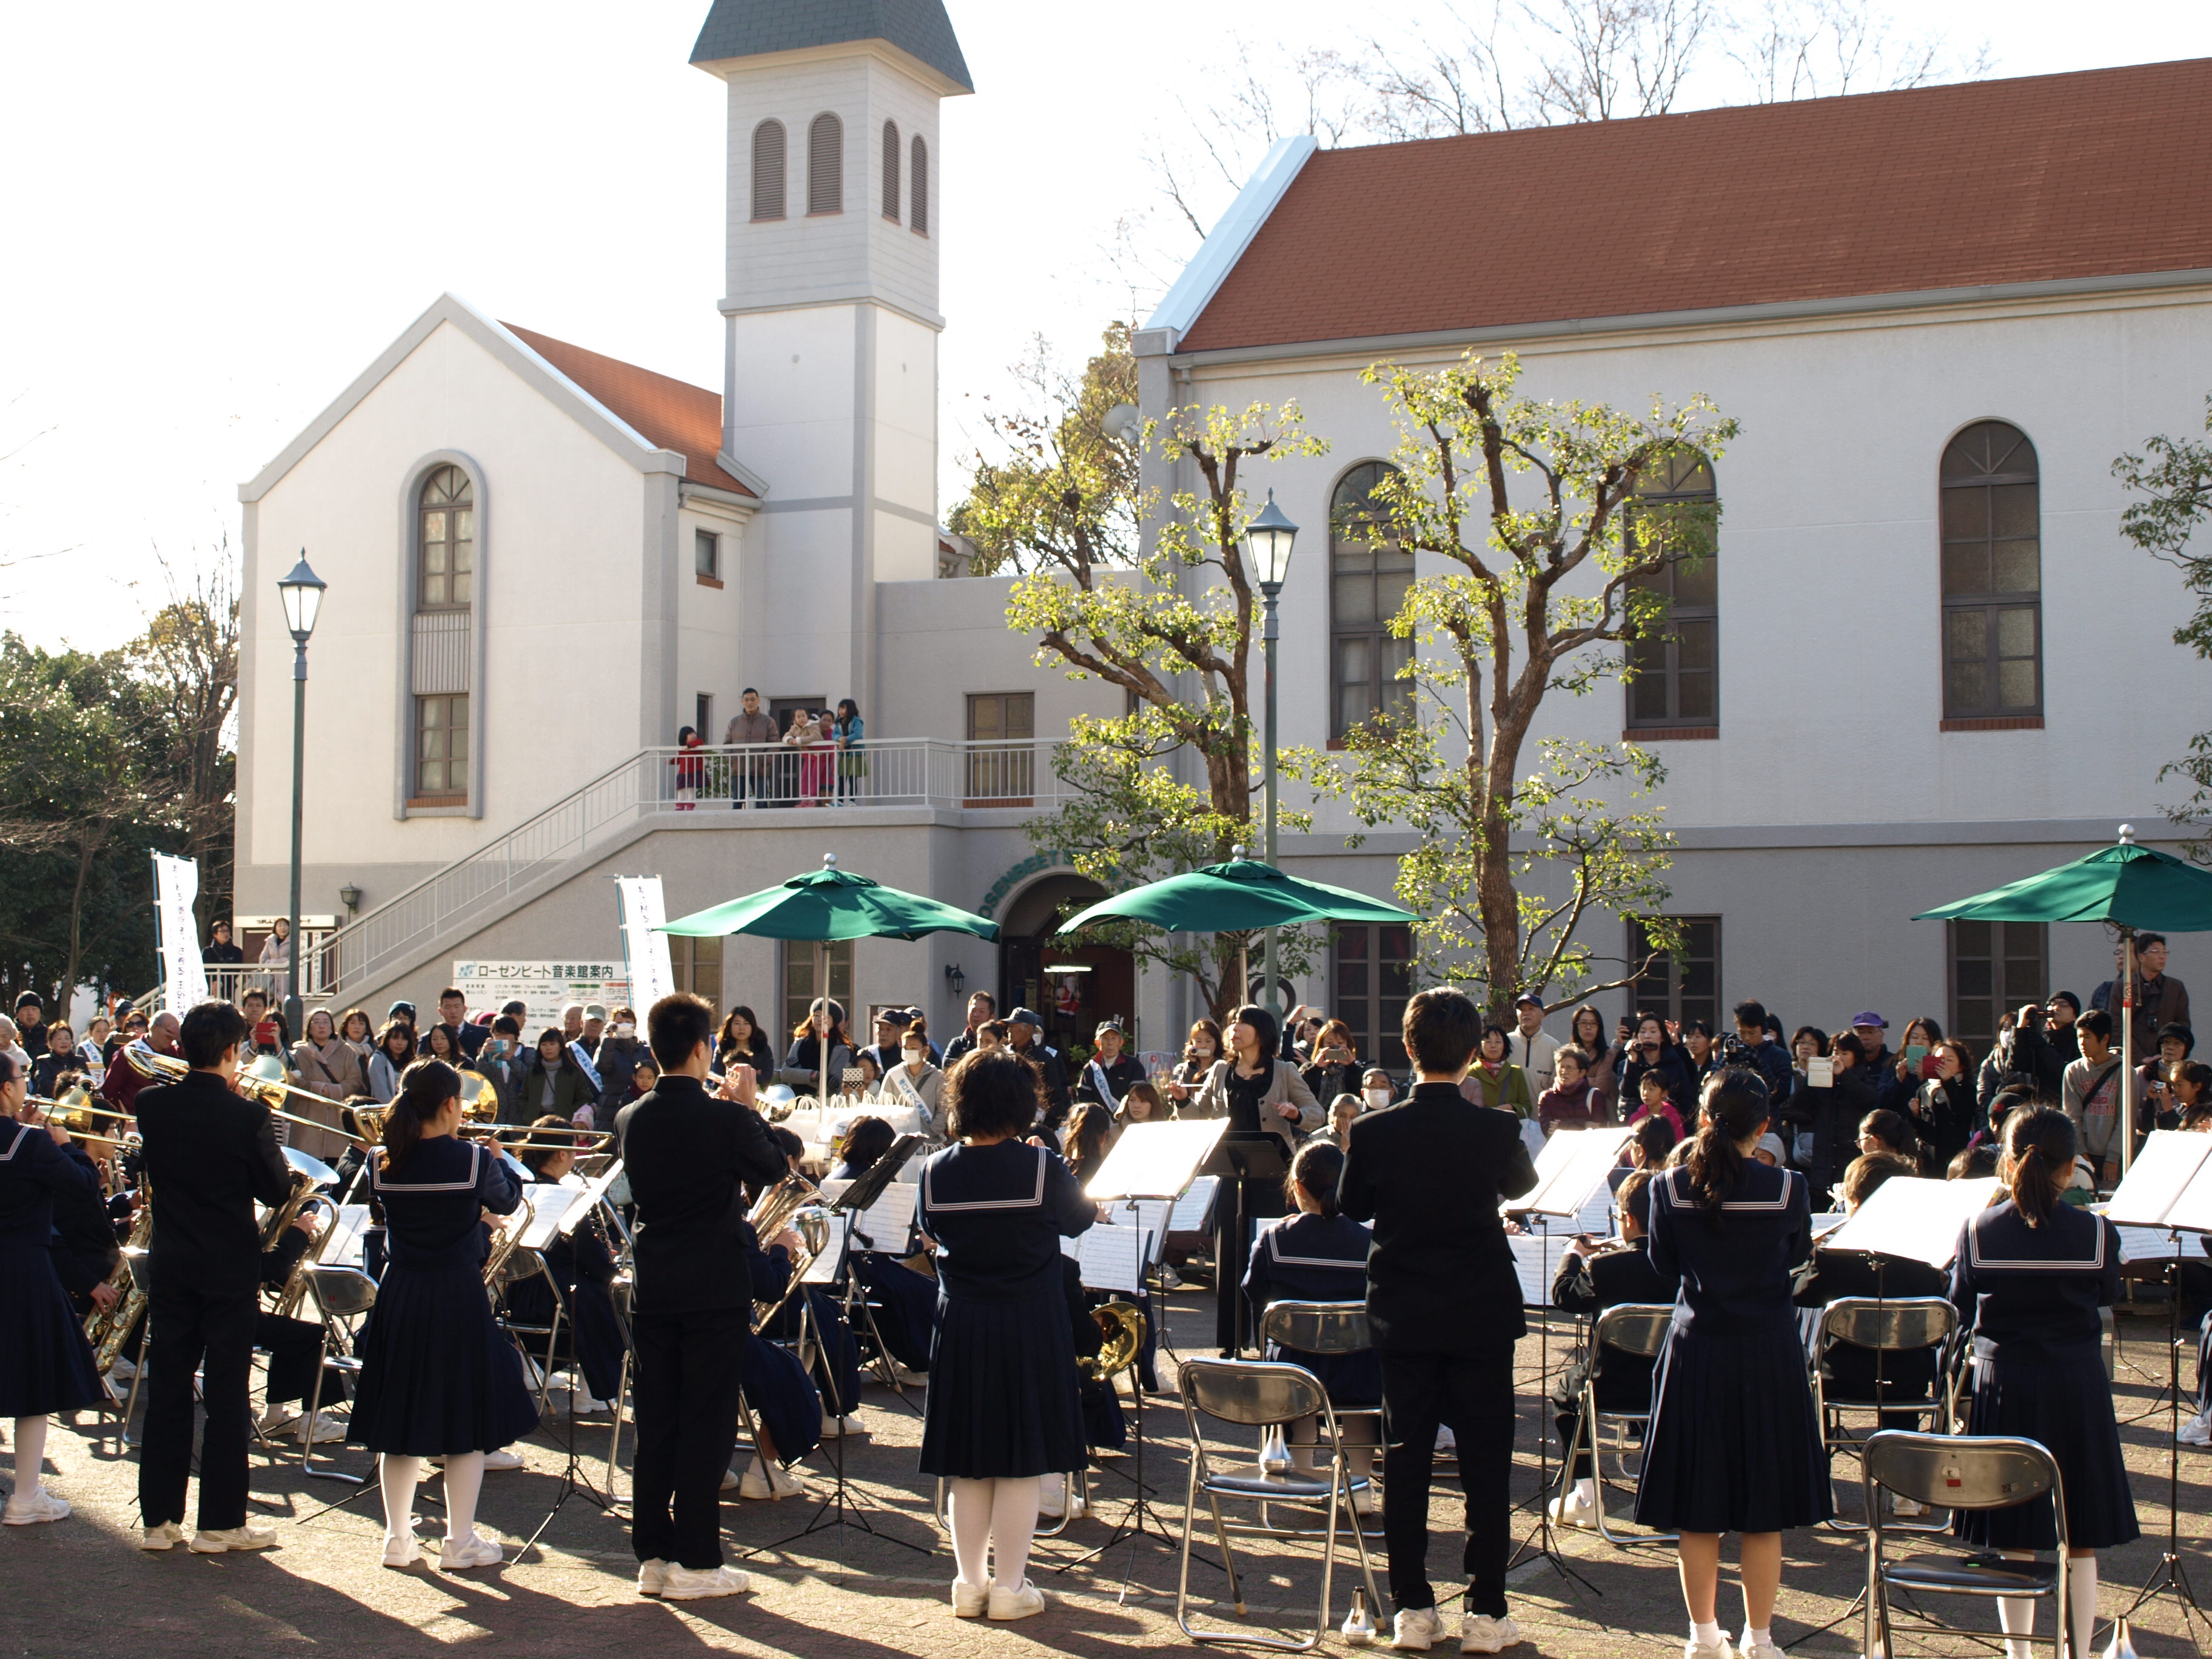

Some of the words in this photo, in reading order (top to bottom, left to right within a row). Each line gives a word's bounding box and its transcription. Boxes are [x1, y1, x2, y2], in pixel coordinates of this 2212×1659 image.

[977, 849, 1059, 919] OSENBEET
[478, 965, 613, 979] ローゼンビート音楽館案内
